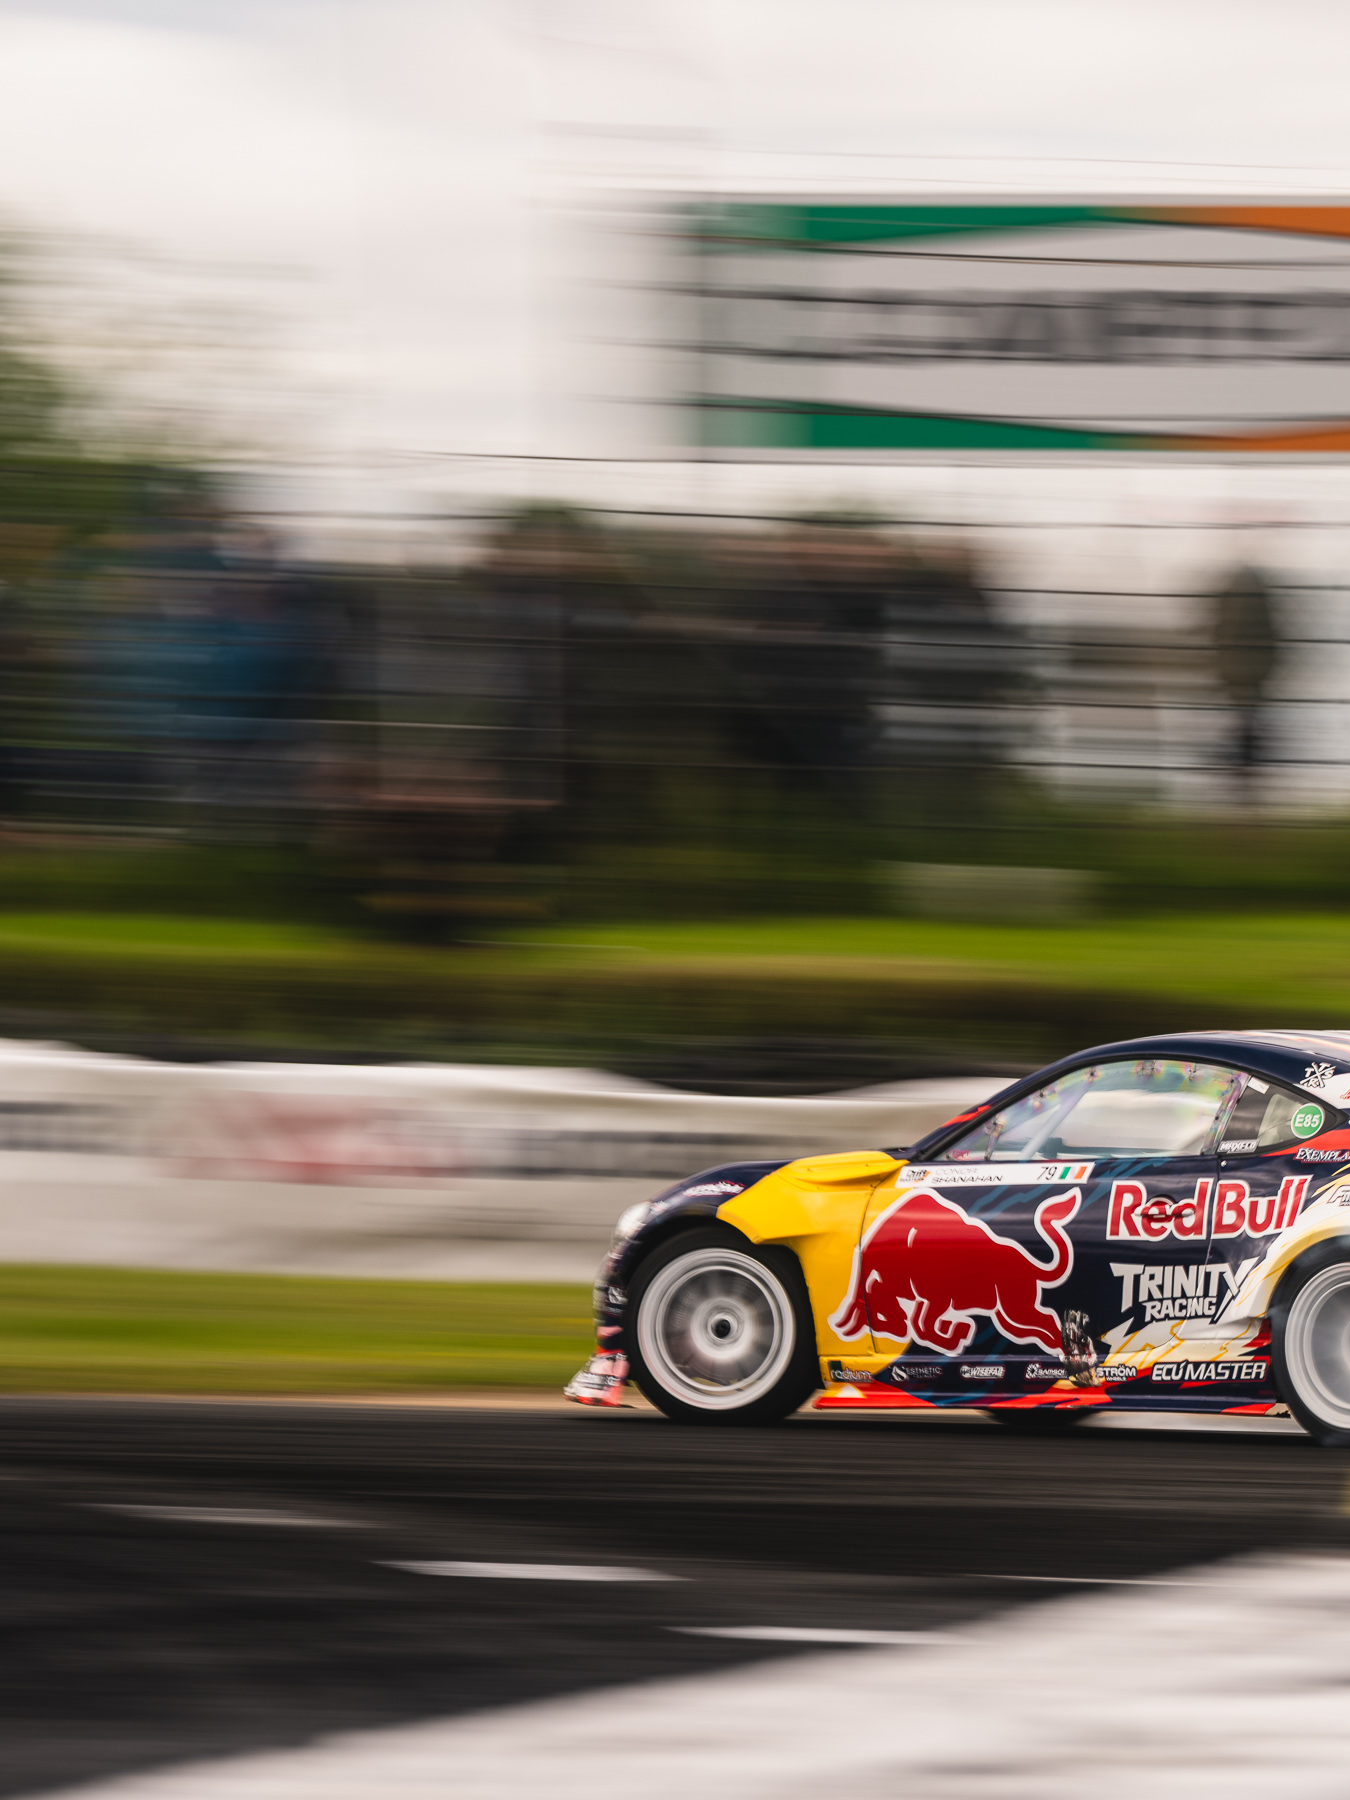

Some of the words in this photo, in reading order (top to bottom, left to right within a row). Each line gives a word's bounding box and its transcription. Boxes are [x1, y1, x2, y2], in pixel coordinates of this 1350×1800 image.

[1294, 1113, 1321, 1128] E85
[931, 1175, 1003, 1184] SHANAHAN
[935, 1168, 978, 1176] CONOR
[1037, 1166, 1058, 1181] 79
[1107, 1178, 1213, 1241] Red
[1210, 1175, 1313, 1238] Bull
[1109, 1257, 1259, 1322] TRINITY
[1142, 1297, 1217, 1322] RACING
[830, 1367, 872, 1380] radium
[1096, 1364, 1136, 1378] STRÖM
